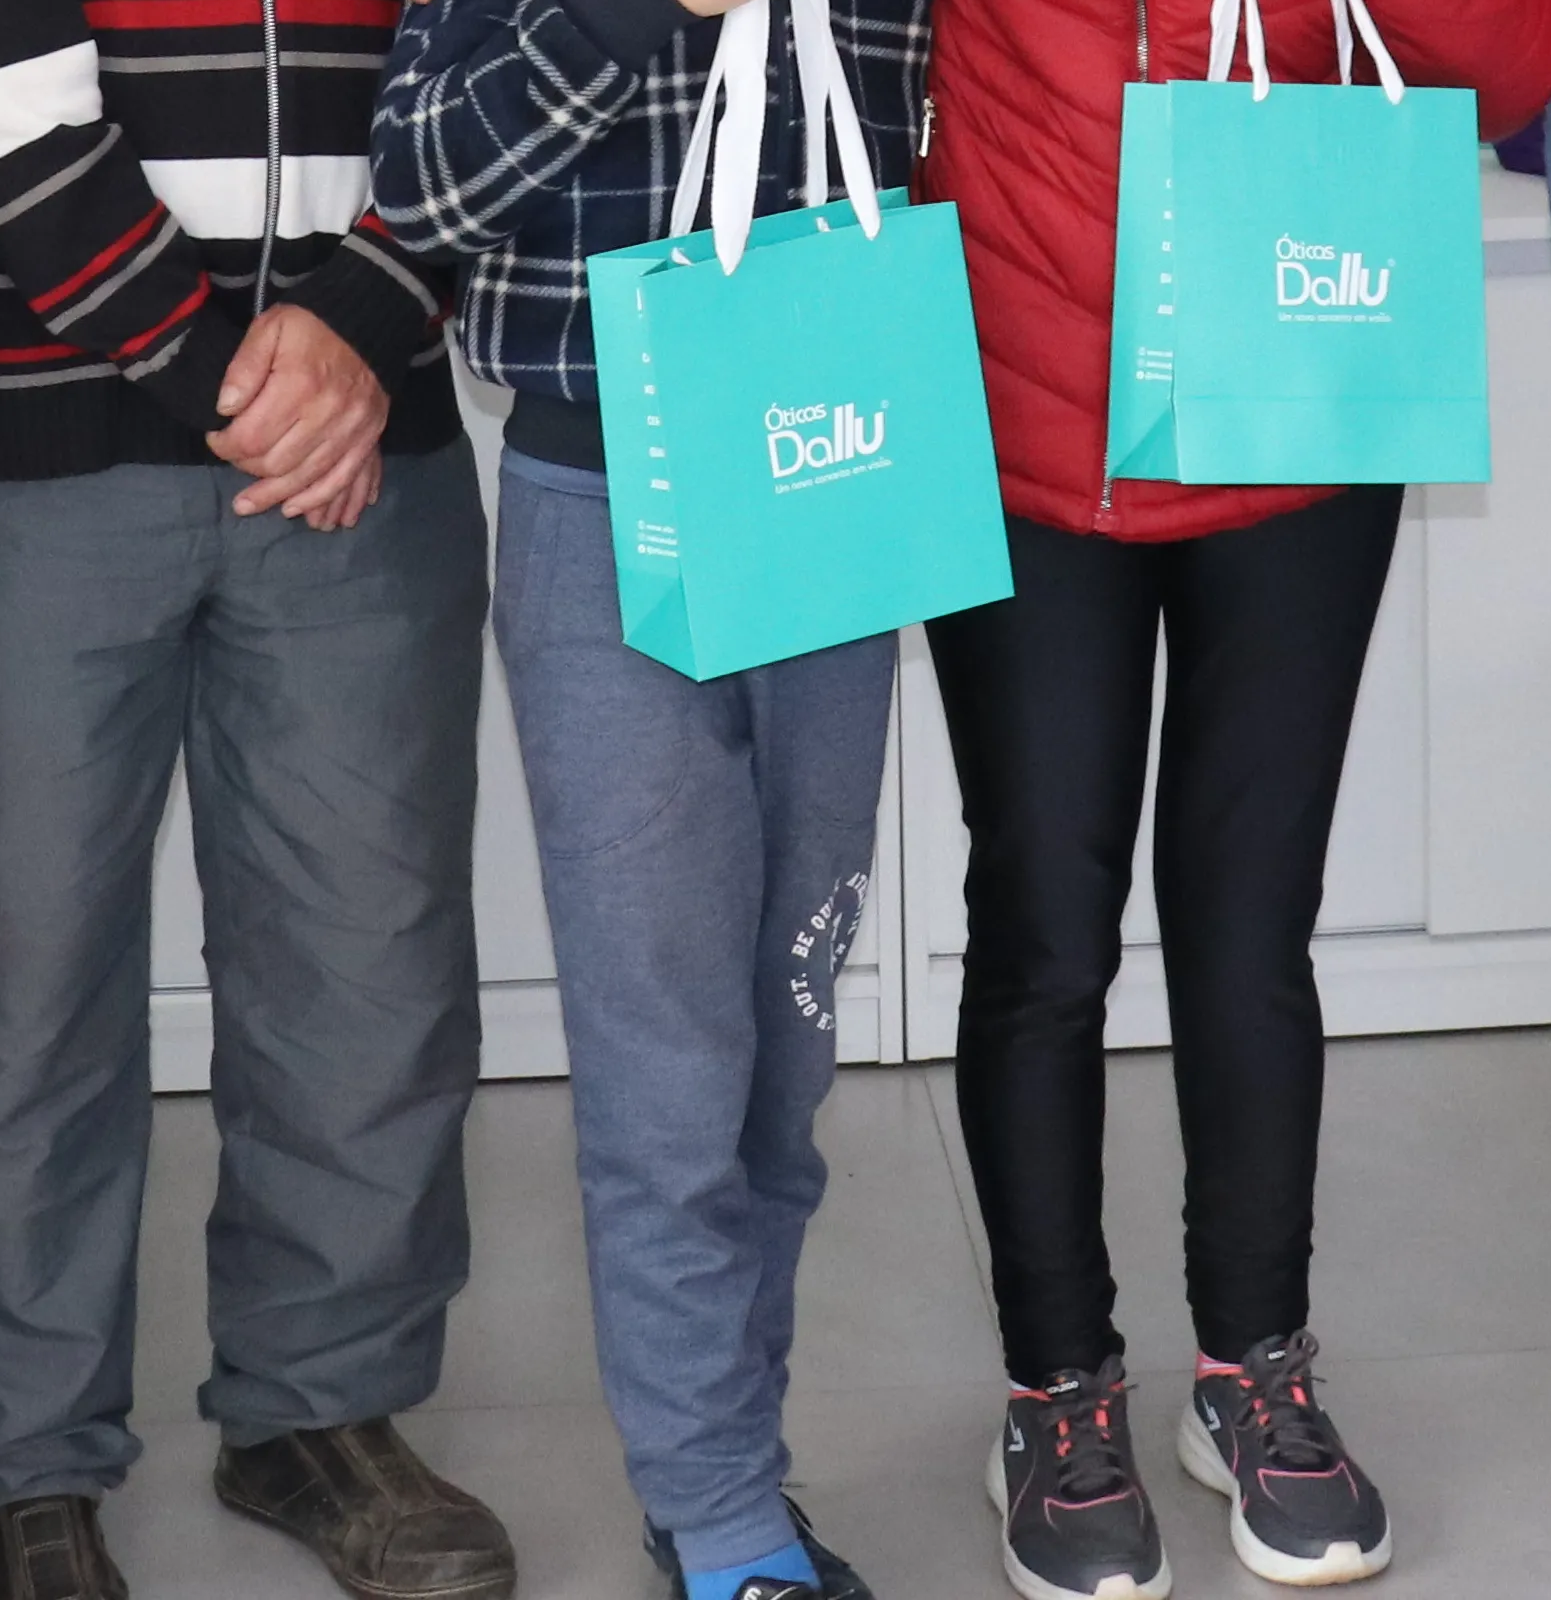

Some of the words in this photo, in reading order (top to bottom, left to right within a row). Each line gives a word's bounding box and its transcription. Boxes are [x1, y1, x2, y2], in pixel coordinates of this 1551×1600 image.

[1275, 232, 1336, 261] Óticas
[1276, 252, 1391, 307] Dallu
[764, 401, 828, 432] Óticas
[767, 402, 885, 479] Dallu
